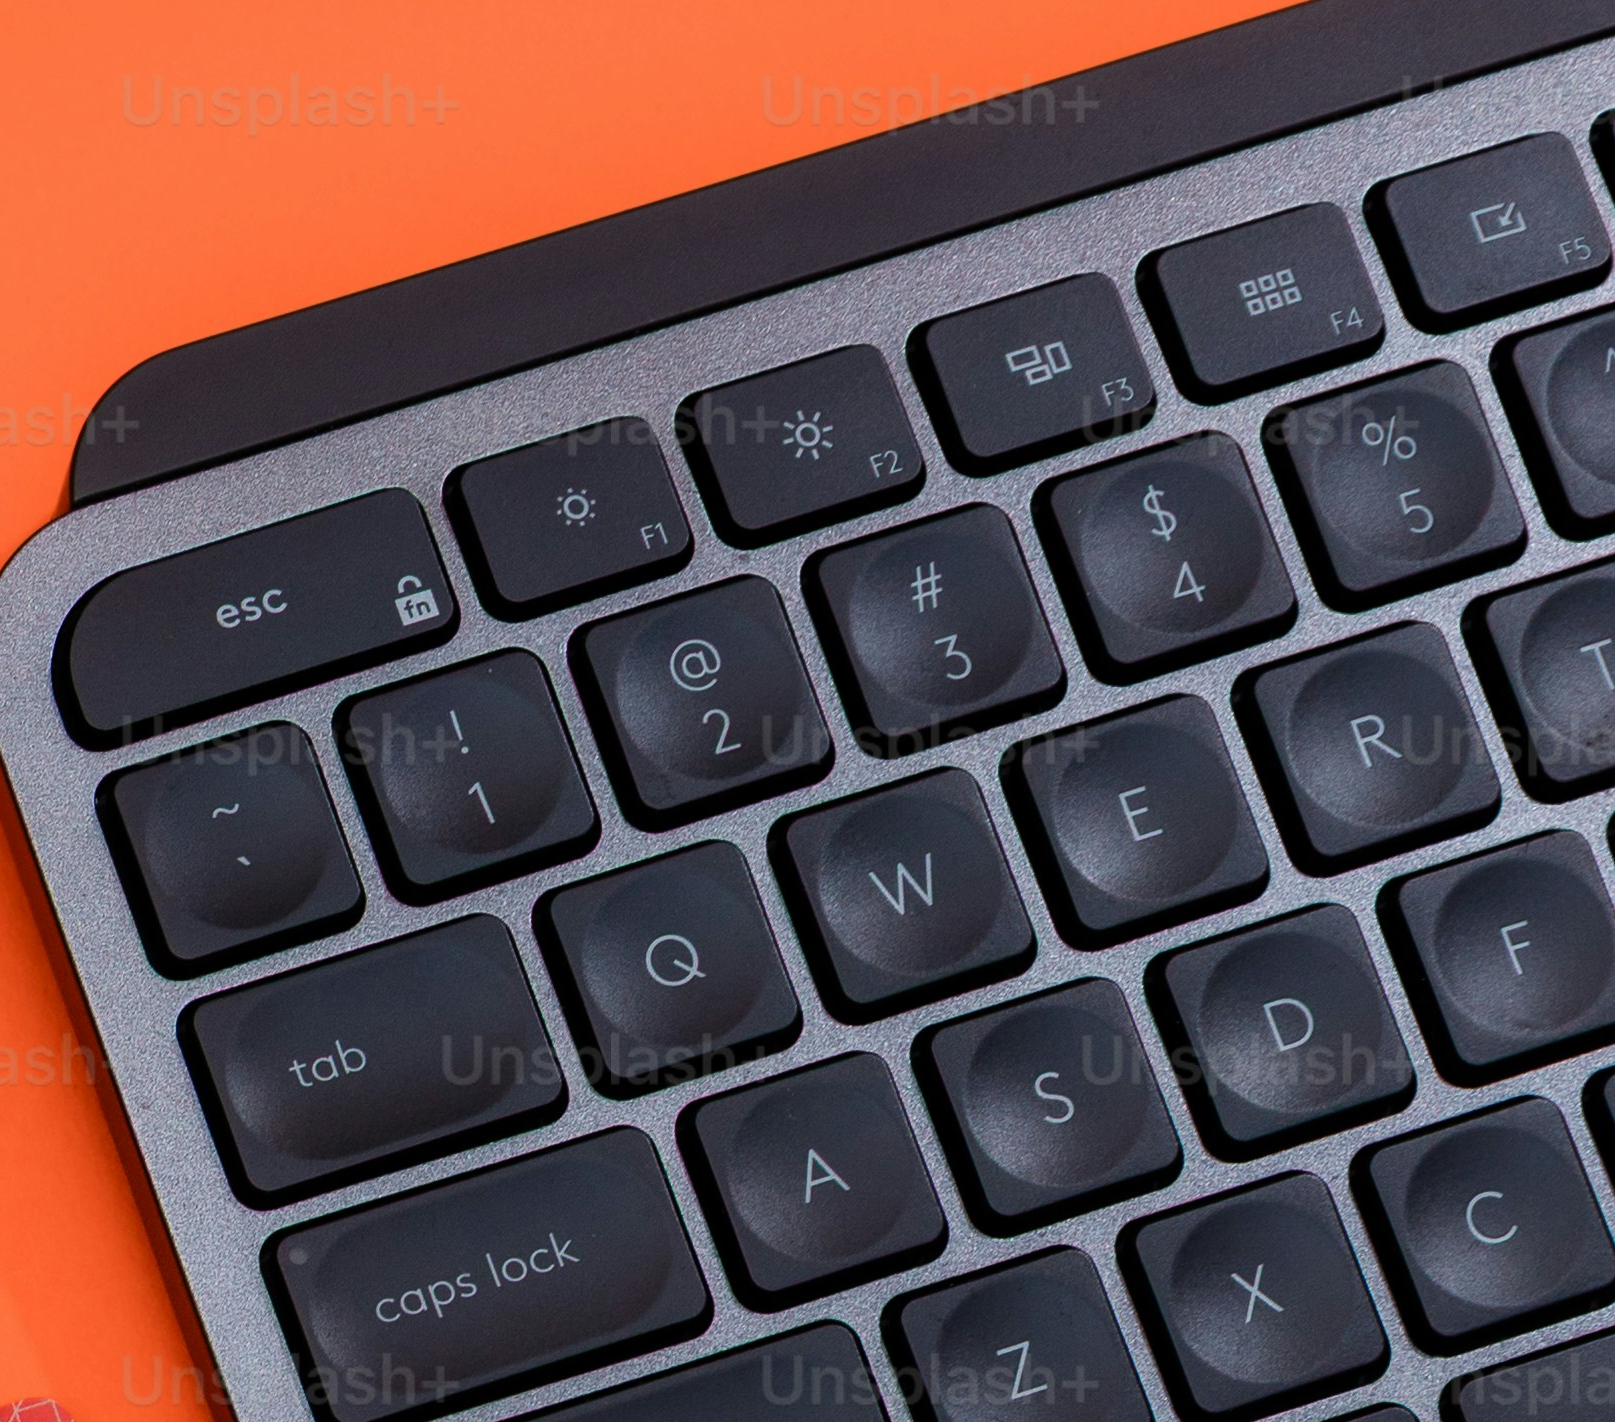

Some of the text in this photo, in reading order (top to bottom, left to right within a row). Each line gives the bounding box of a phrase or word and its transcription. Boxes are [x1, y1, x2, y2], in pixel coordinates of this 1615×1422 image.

[1558, 236, 1592, 264] F5
[1330, 306, 1364, 335] F4
[1101, 377, 1134, 406] F3
[869, 450, 903, 478] F2
[1361, 416, 1417, 466] %
[640, 522, 668, 550] F1
[1143, 484, 1177, 542] $
[1398, 488, 1434, 533] 5
[910, 561, 943, 613] #
[1173, 561, 1206, 602] 4
[216, 589, 288, 629] esc
[401, 596, 434, 620] fn
[669, 639, 721, 692] @
[934, 634, 972, 680] 3
[1580, 639, 1615, 691] T
[702, 708, 742, 755] 2
[1350, 714, 1402, 769] R
[467, 781, 495, 824] 1
[1118, 786, 1163, 842] E
[866, 851, 936, 916] W
[645, 934, 706, 987] Q
[1500, 921, 1530, 976] F
[1263, 997, 1315, 1053] D
[288, 1039, 367, 1087] tab
[1034, 1071, 1075, 1124] S
[804, 1148, 851, 1204] A
[1466, 1191, 1518, 1245] C
[375, 1232, 580, 1323] caps lock
[1230, 1264, 1284, 1325] X
[996, 1340, 1048, 1401] Z
